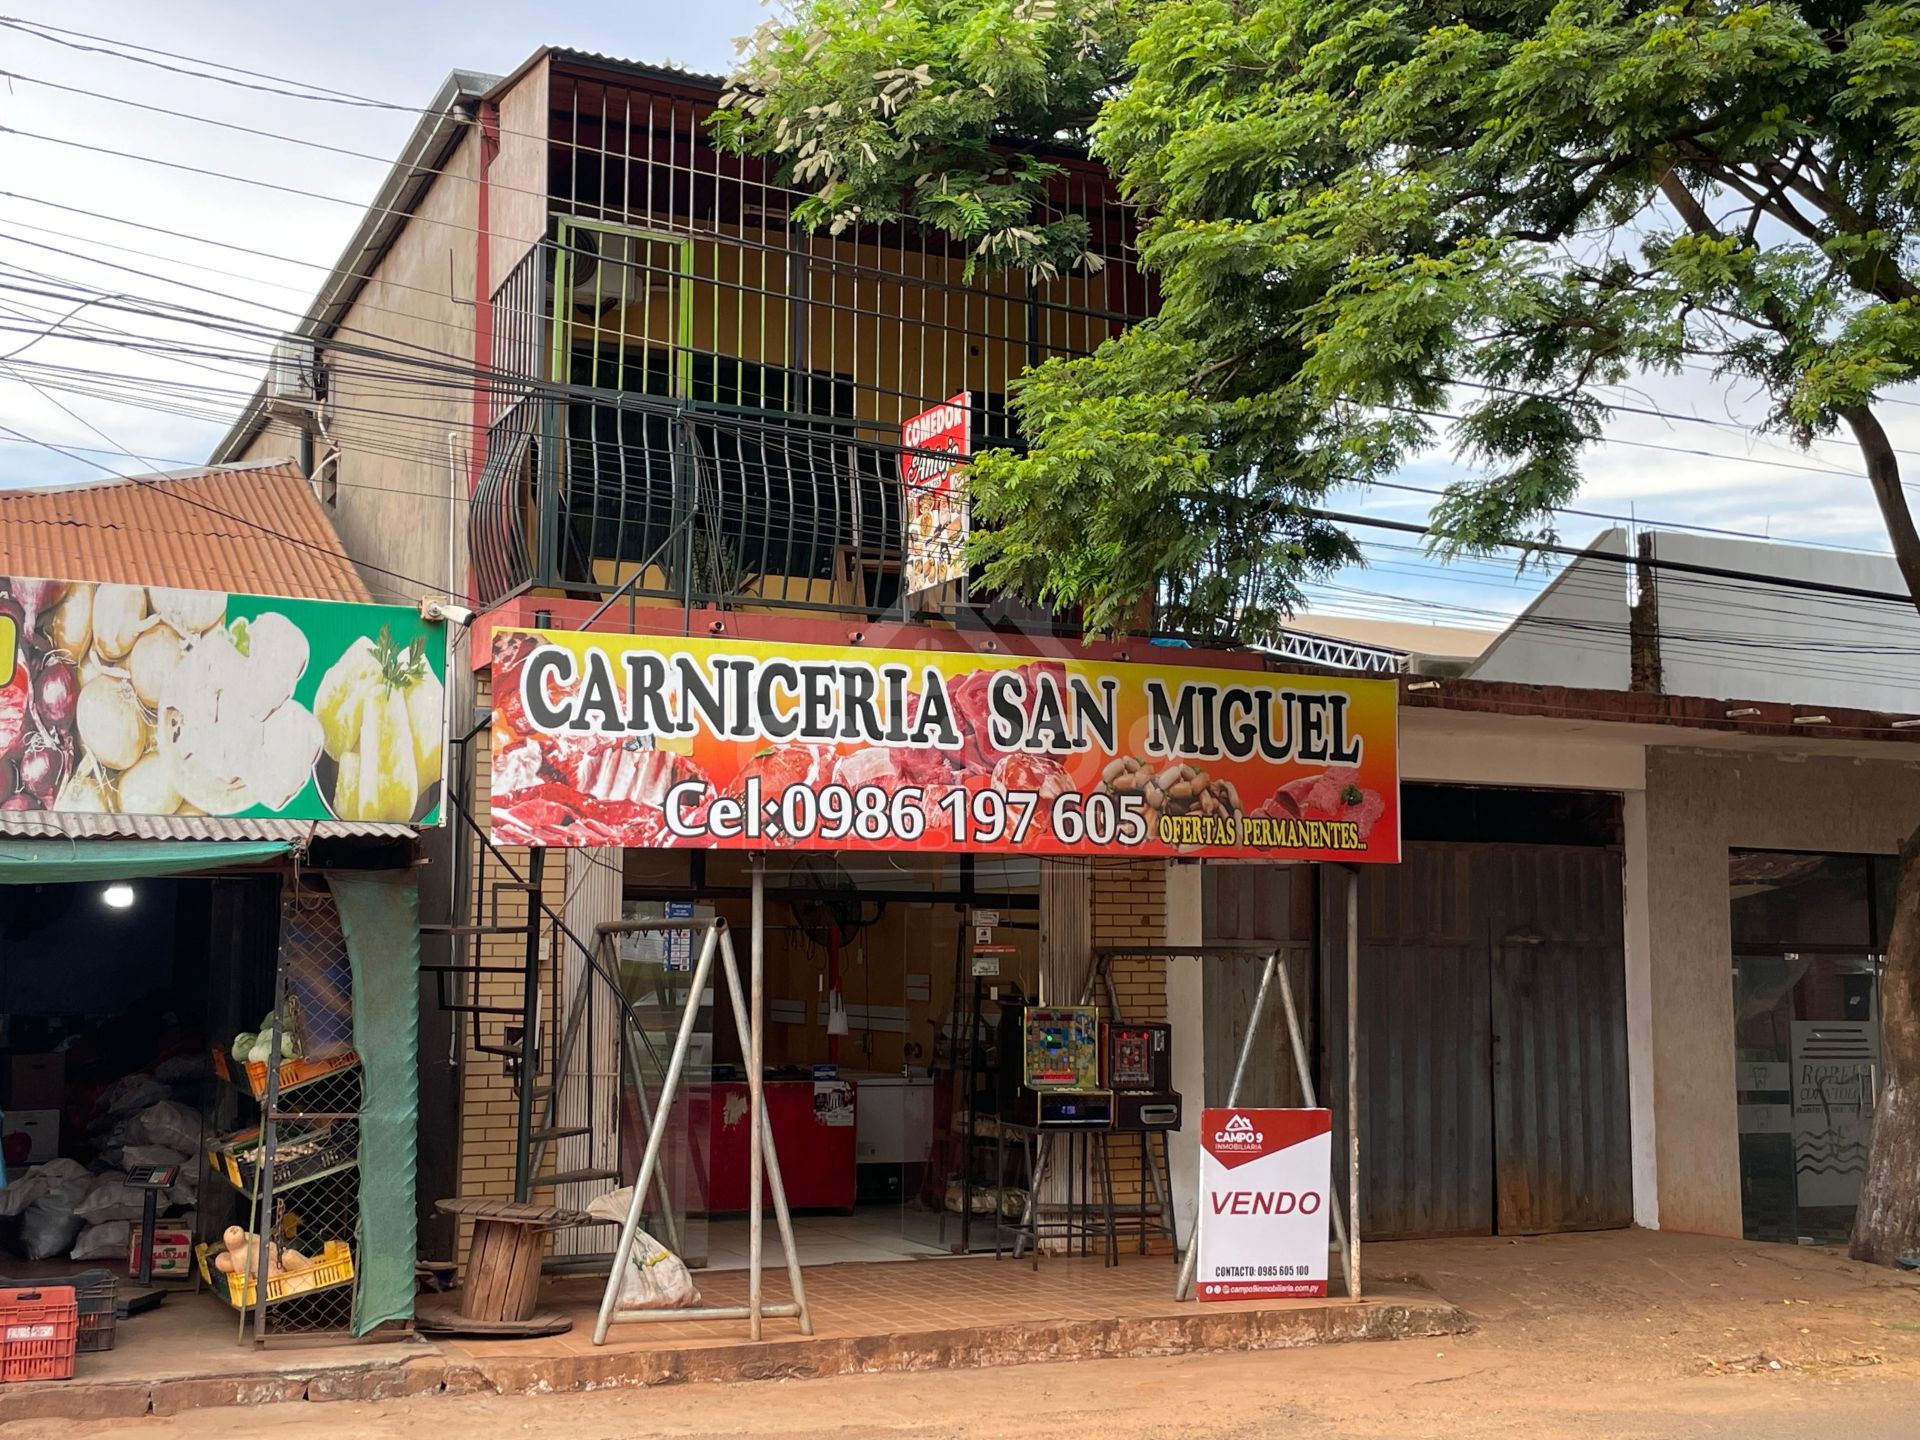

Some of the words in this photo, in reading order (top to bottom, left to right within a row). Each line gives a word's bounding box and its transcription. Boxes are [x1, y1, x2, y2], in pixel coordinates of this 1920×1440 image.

[905, 400, 963, 448] COMEDOR
[521, 645, 964, 749] CARNICERIA
[989, 671, 1118, 755] SAN
[1145, 681, 1363, 767] MIGUEL
[664, 777, 926, 842] Cel:0986
[938, 788, 1040, 845] 197
[1052, 790, 1147, 847] 605
[1159, 815, 1236, 845] OFERTAS
[1214, 1131, 1255, 1143] CAMPO
[1255, 1132, 1264, 1143] 9
[1211, 1191, 1321, 1215] VENDO
[1215, 1266, 1256, 1277] CONTACTO:
[1257, 1265, 1278, 1276] 0985
[1279, 1265, 1294, 1276] 605
[1296, 1265, 1309, 1276] 100
